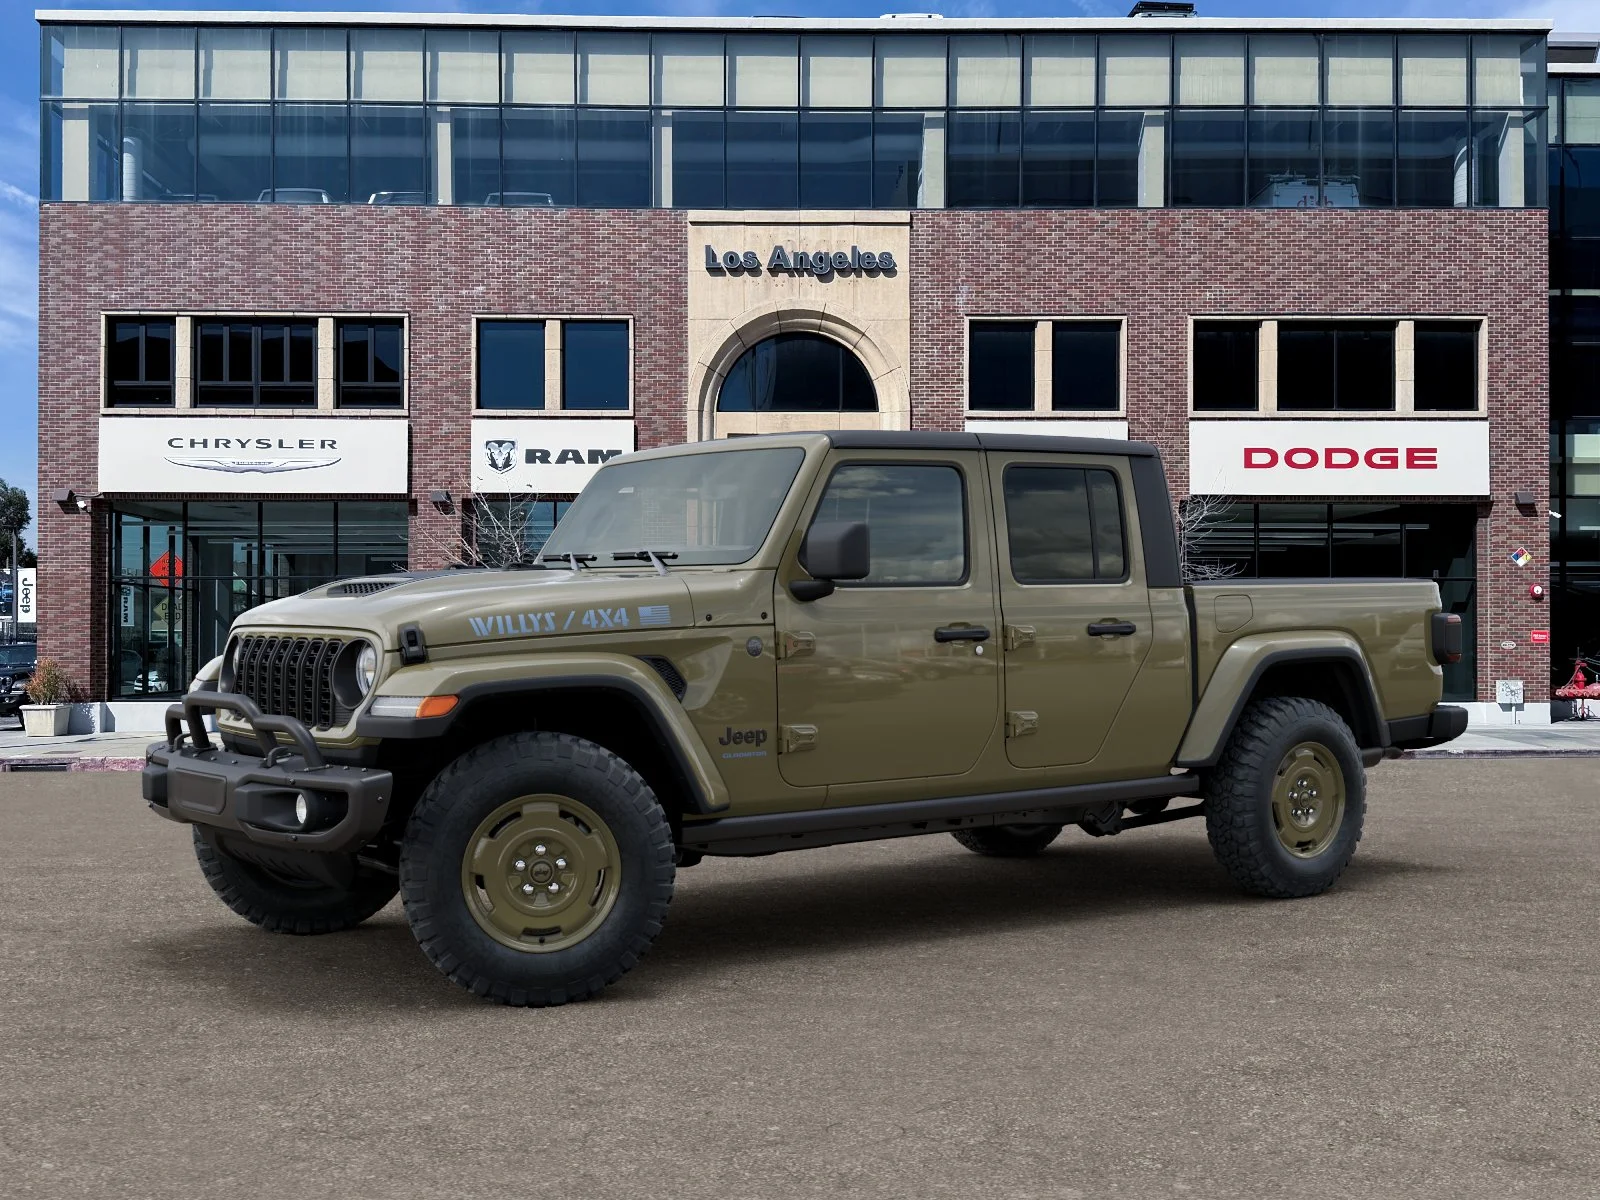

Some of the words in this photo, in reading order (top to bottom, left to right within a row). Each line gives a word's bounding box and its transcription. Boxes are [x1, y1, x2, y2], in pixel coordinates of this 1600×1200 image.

[705, 245, 758, 270] Los
[767, 245, 895, 275] Angeles
[167, 437, 338, 450] CHRYSLER
[1243, 447, 1438, 469] DODGE
[20, 577, 34, 613] Jeep
[164, 612, 181, 620] ED
[468, 612, 556, 637] WILLYS
[581, 607, 630, 629] 4X4
[718, 726, 768, 747] Jeep
